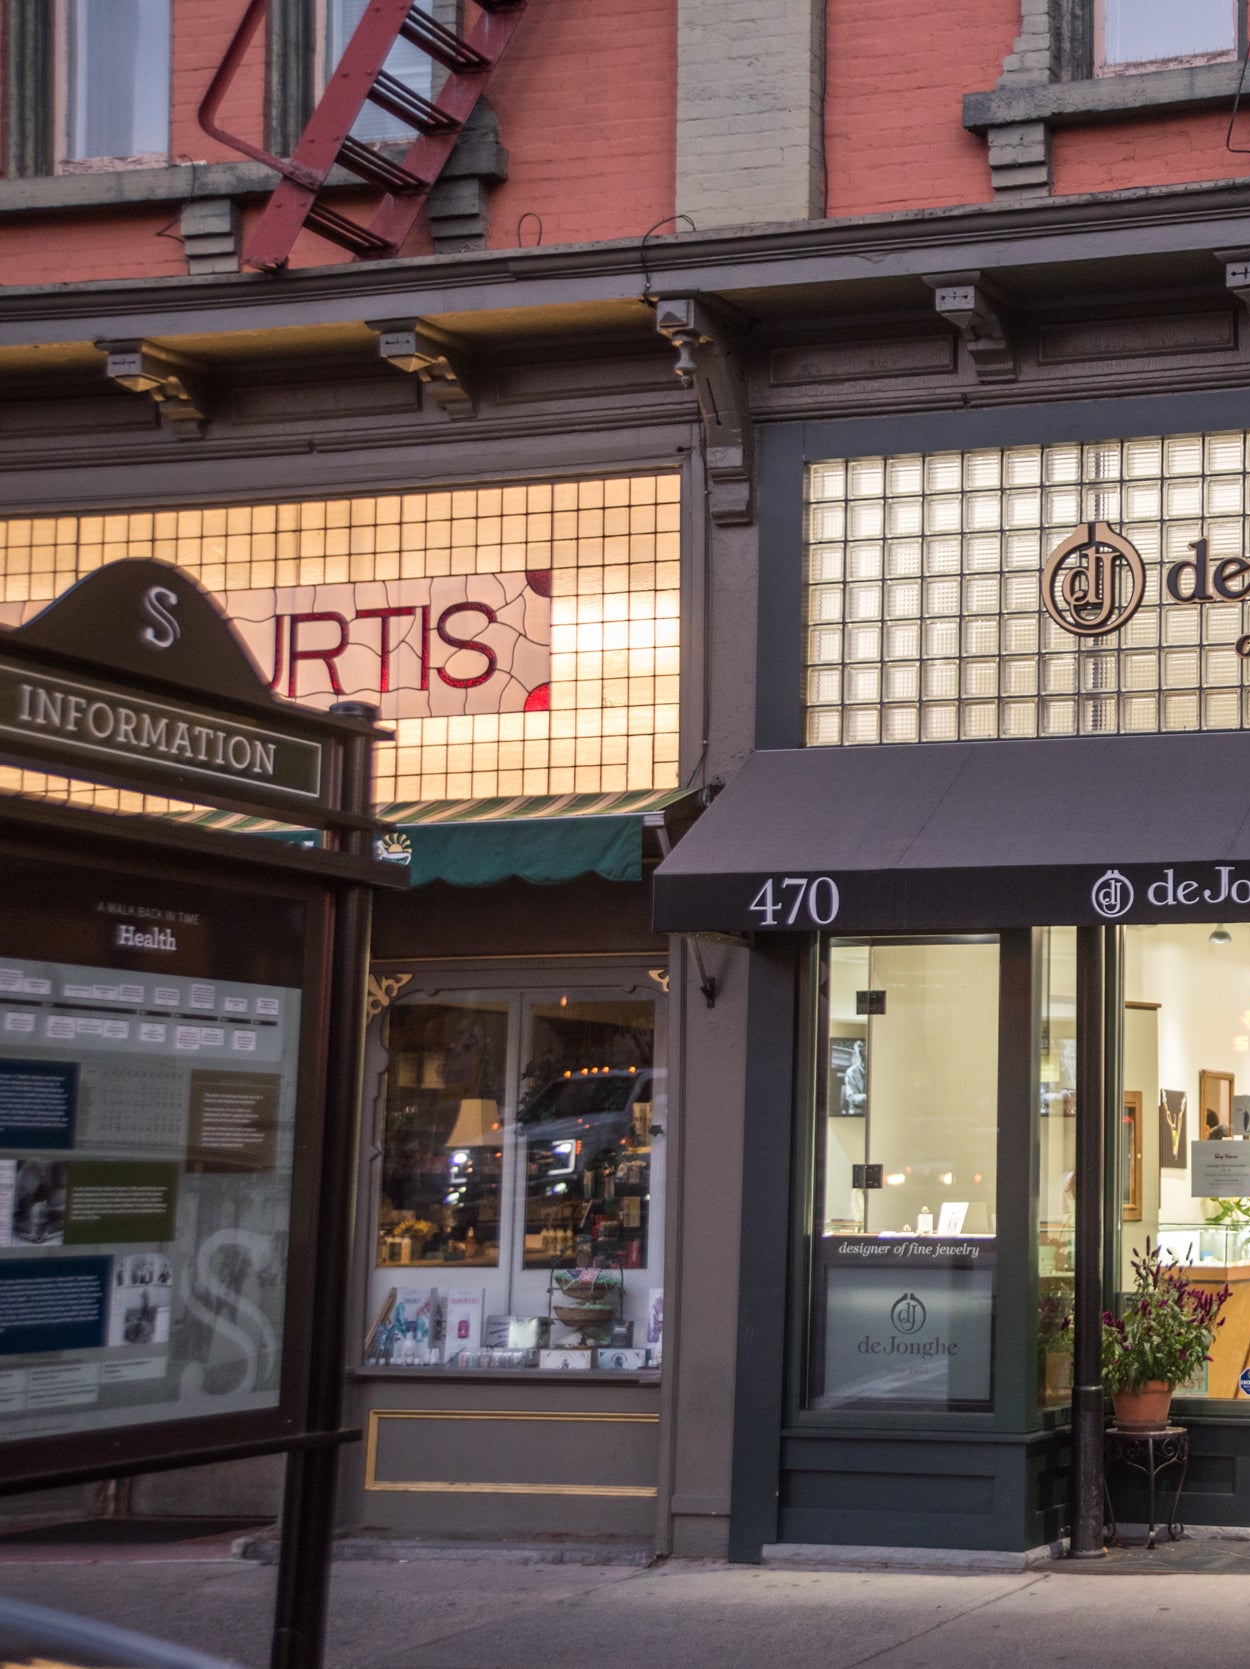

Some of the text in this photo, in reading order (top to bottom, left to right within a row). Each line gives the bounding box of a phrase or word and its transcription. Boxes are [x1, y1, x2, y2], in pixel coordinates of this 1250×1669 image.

[19, 684, 277, 777] INFORMATION
[749, 876, 841, 926] 470
[118, 924, 177, 951] Health
[838, 1242, 980, 1258] designer of fine jewelry
